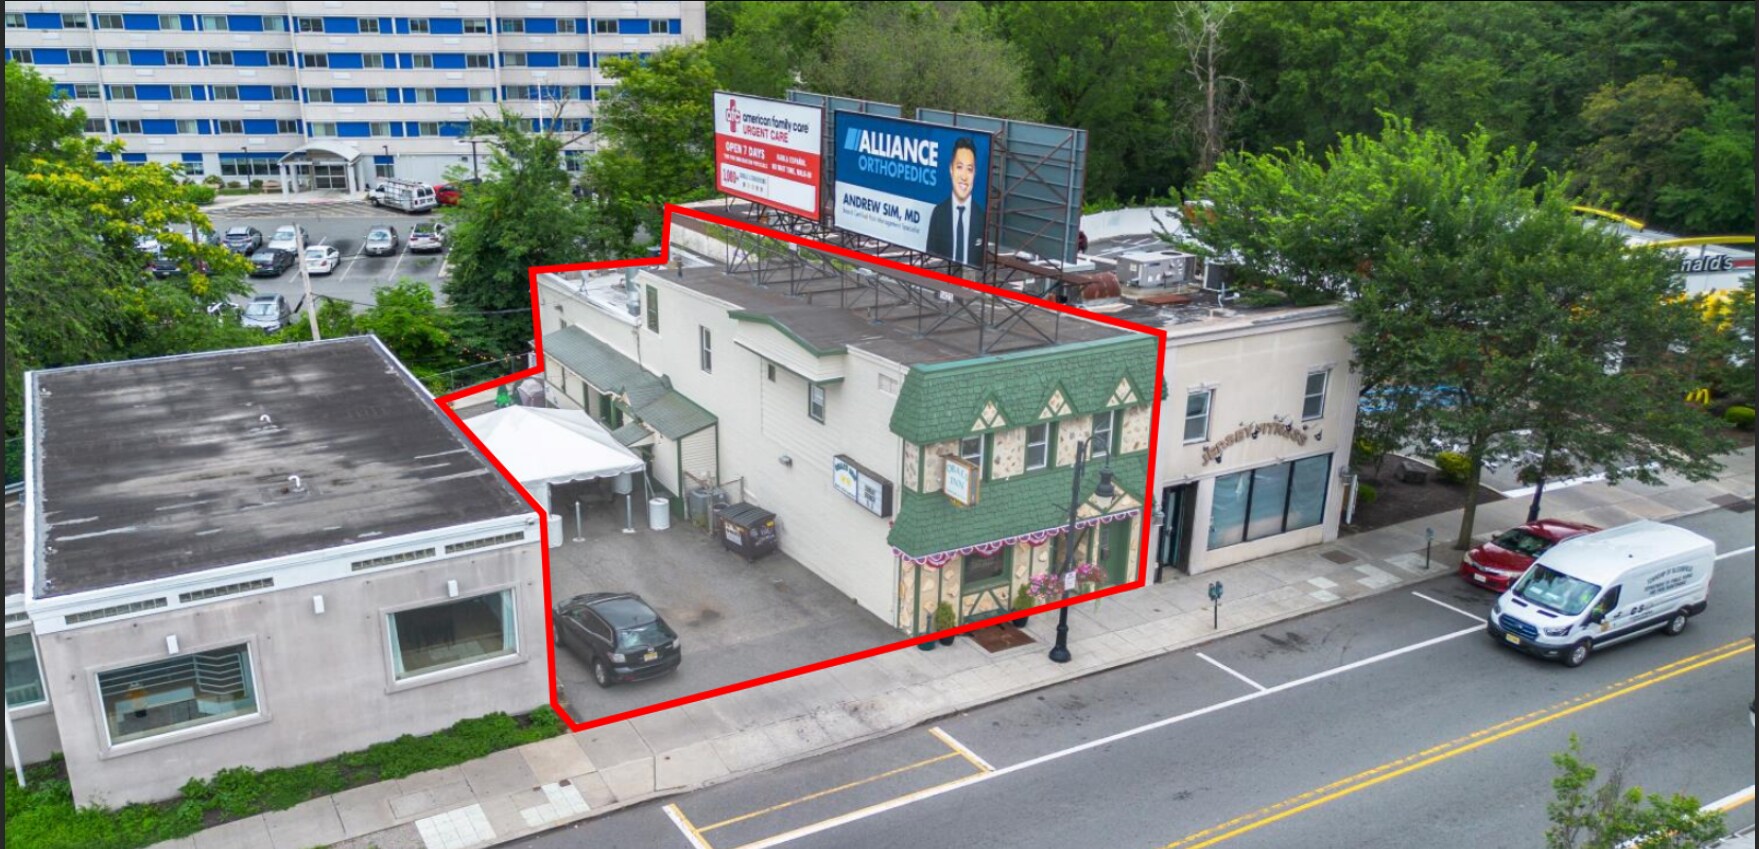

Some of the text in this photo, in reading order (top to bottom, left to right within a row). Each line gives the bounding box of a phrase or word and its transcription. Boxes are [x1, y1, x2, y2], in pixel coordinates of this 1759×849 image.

[743, 113, 809, 133] american family care
[743, 125, 789, 143] URGENT CARE
[725, 141, 742, 154] OPEN
[749, 146, 765, 160] DAYS
[859, 130, 938, 167] ALLIANCE
[858, 155, 937, 186] ORTHOPEDICS
[843, 193, 920, 224] ANDREW SIM, MD
[1681, 254, 1734, 272] nald's
